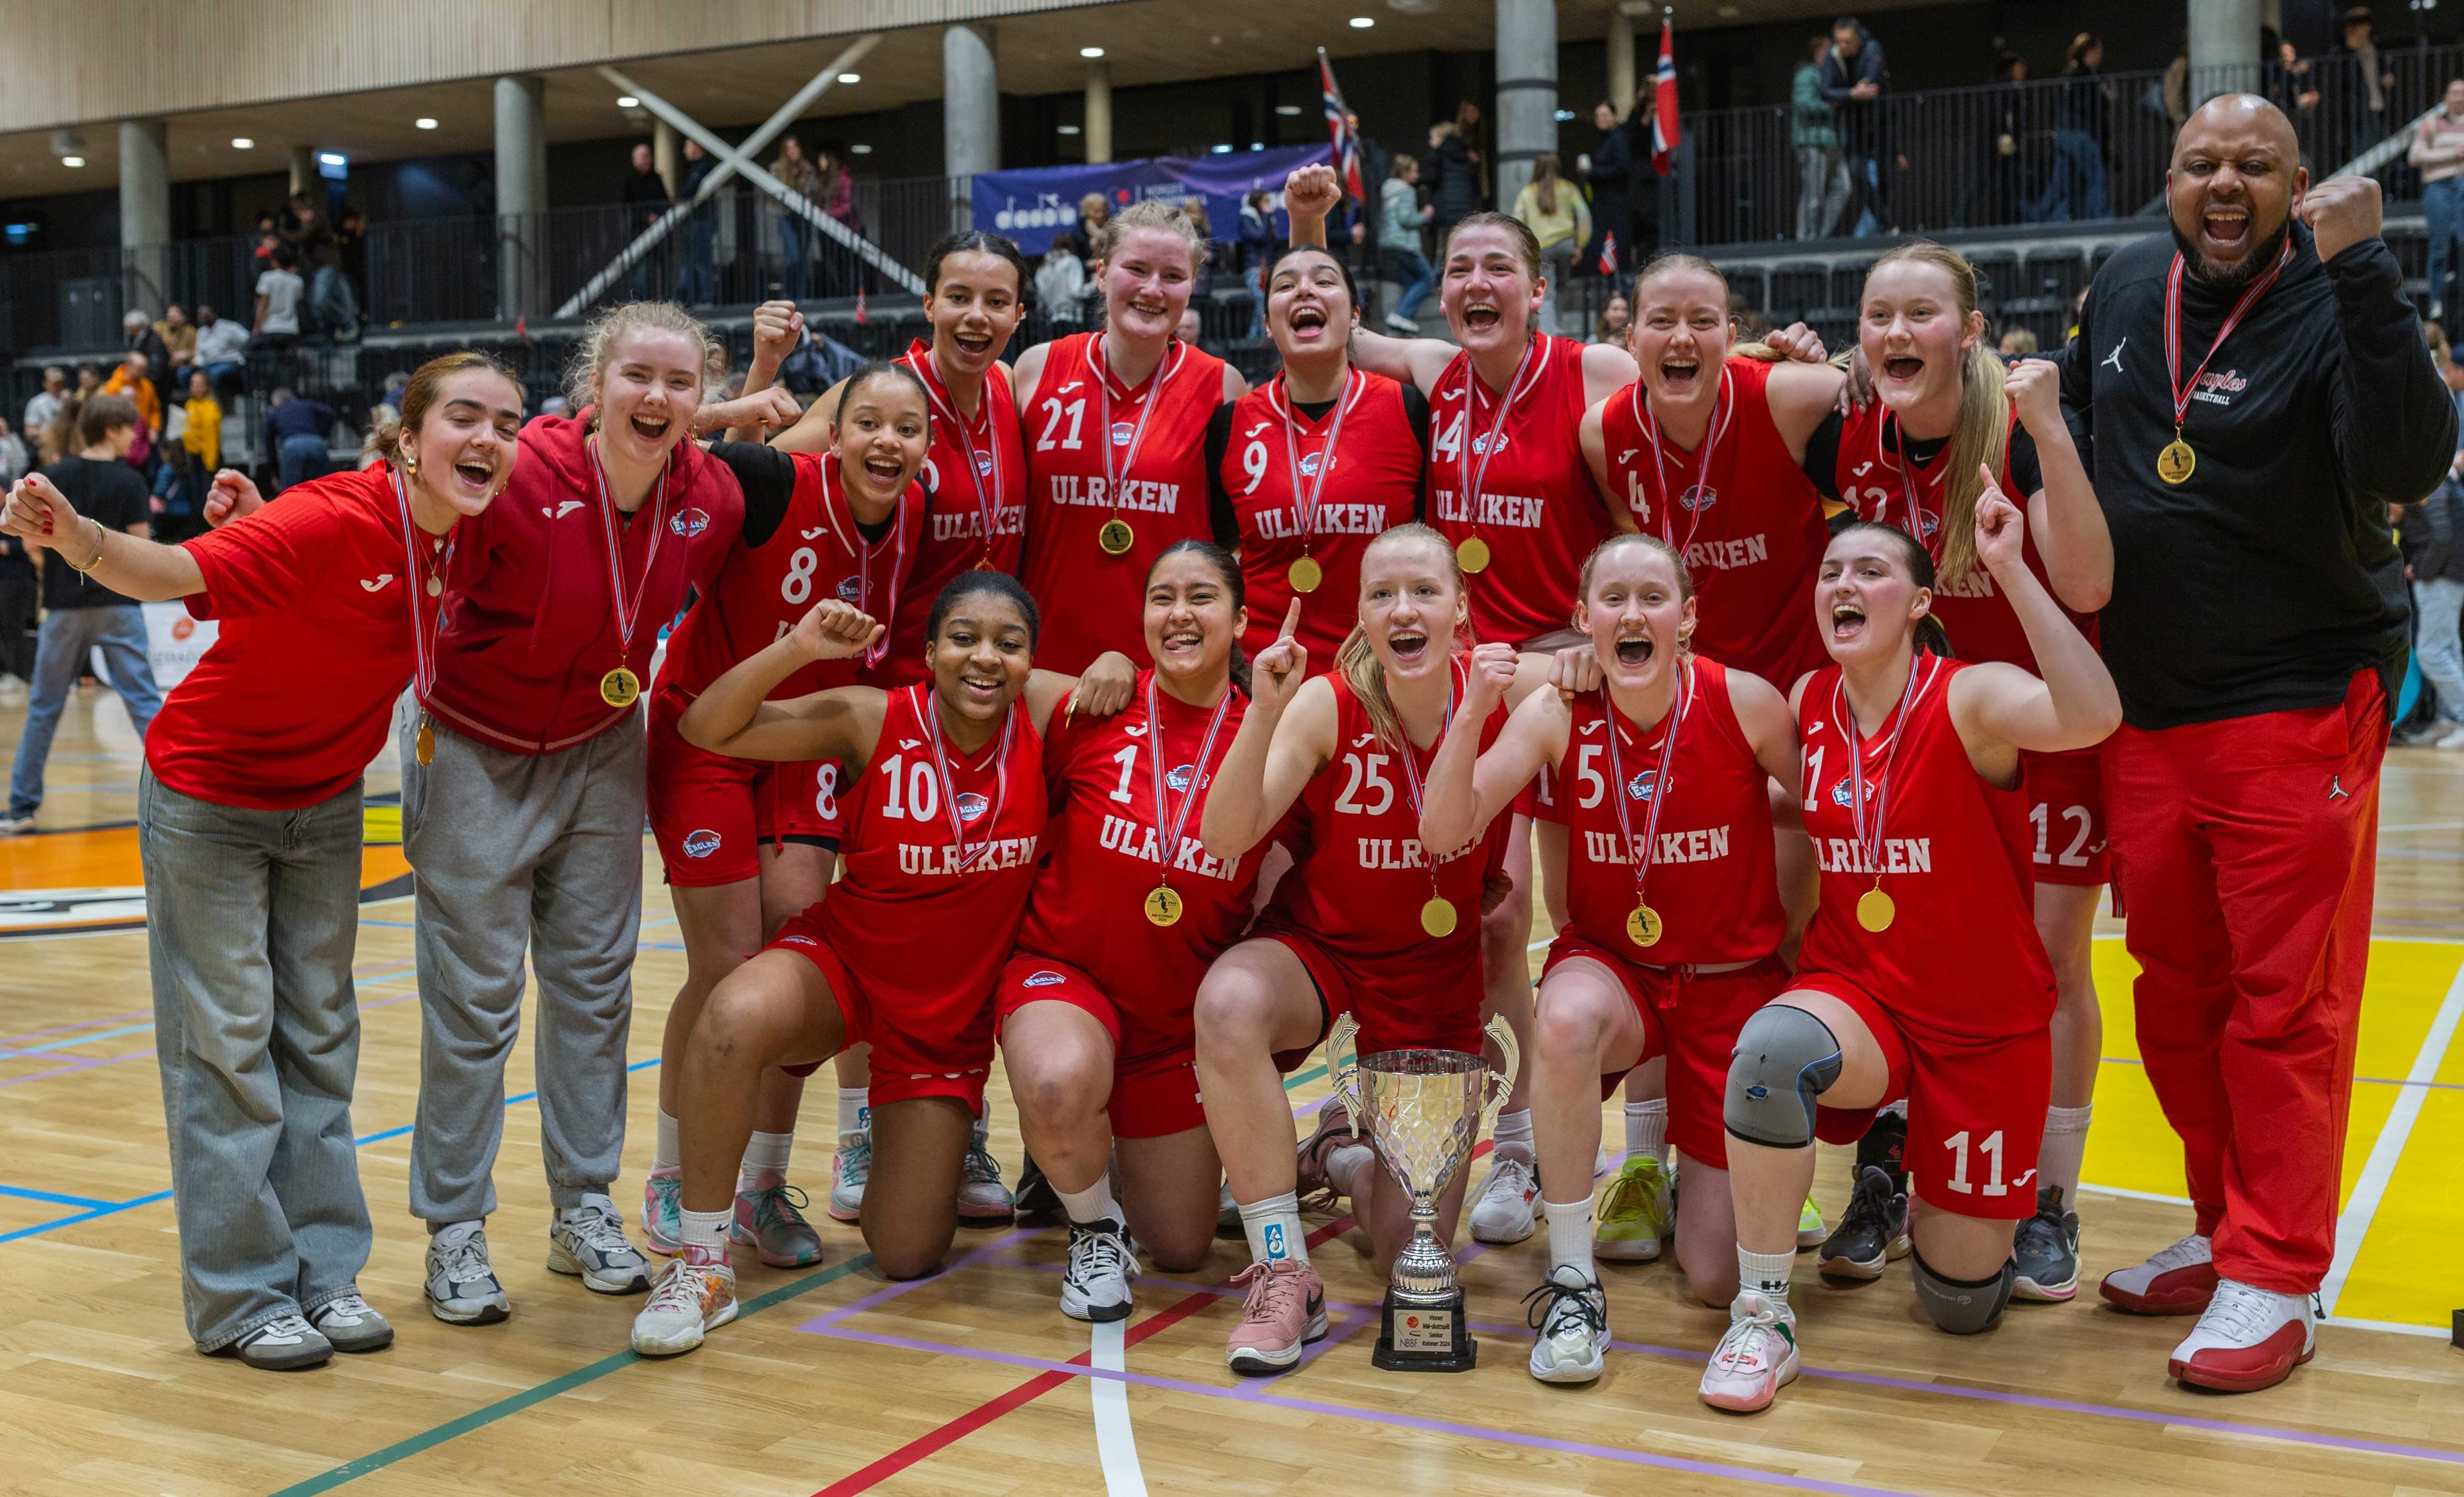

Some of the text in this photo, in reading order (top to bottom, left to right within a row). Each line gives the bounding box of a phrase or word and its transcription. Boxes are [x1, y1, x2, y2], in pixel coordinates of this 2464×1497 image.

[2193, 390, 2230, 405] BASKETBALL
[2199, 370, 2247, 393] agles
[1037, 397, 1086, 452] 21
[1431, 409, 1465, 463] 14
[1050, 475, 1180, 514] ULRKEN
[1243, 440, 1268, 496] 9
[933, 504, 1027, 542] ULRKEN
[1628, 470, 1651, 524] 4
[672, 520, 705, 532] EALES
[781, 546, 818, 604] 8
[839, 585, 860, 596] EAGL
[816, 763, 838, 820] 8
[880, 754, 938, 822] 10
[1109, 744, 1138, 804] 1
[1335, 753, 1394, 816] 25
[1578, 744, 1604, 809] 5
[960, 804, 987, 814] AGLES
[2029, 802, 2092, 868] 12
[688, 841, 718, 856] EAGLES
[1099, 814, 1242, 882] ULRKEN
[1810, 835, 1932, 873] LRIEN
[1943, 1130, 2007, 1196] 11
[1400, 1338, 1418, 1347] NBBF
